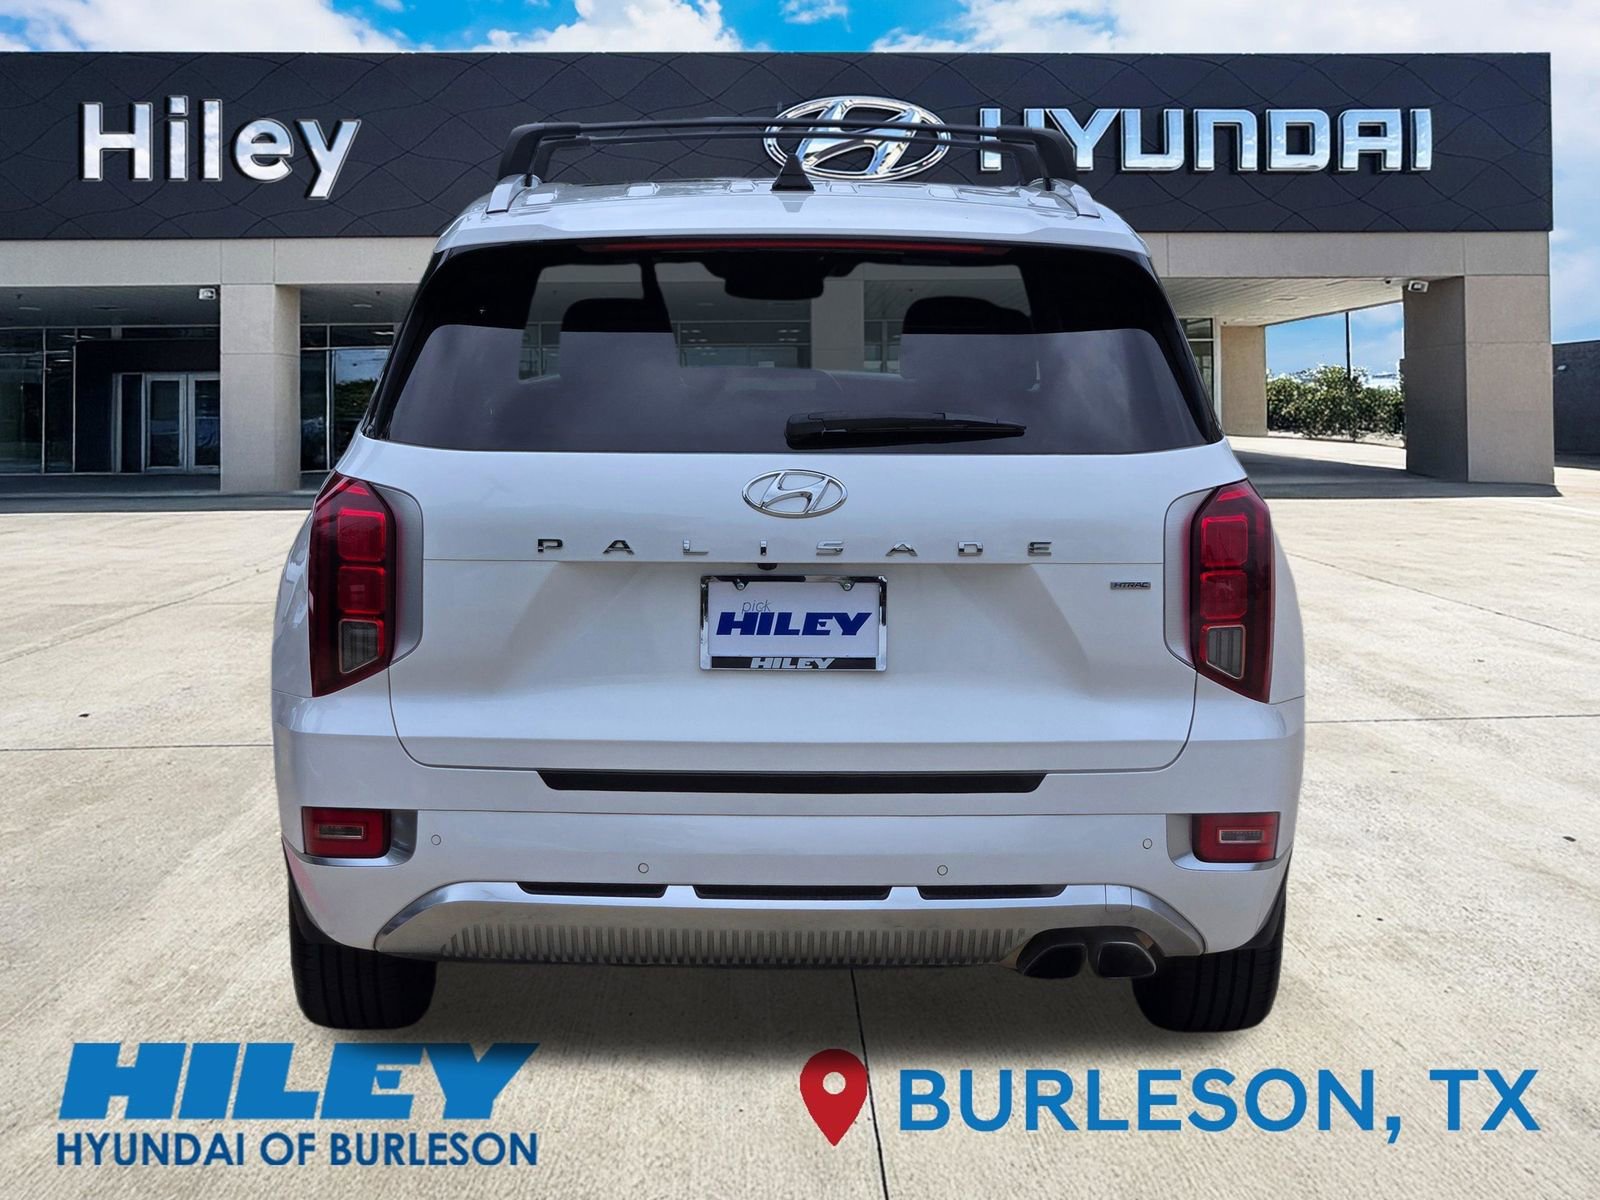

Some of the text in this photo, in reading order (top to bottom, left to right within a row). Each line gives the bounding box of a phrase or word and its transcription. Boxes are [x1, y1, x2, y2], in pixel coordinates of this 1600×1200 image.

[80, 95, 362, 200] Hiley
[537, 537, 1053, 557] PALISADE
[742, 599, 772, 613] pick
[716, 612, 872, 636] HILEY
[750, 657, 836, 669] HILEY
